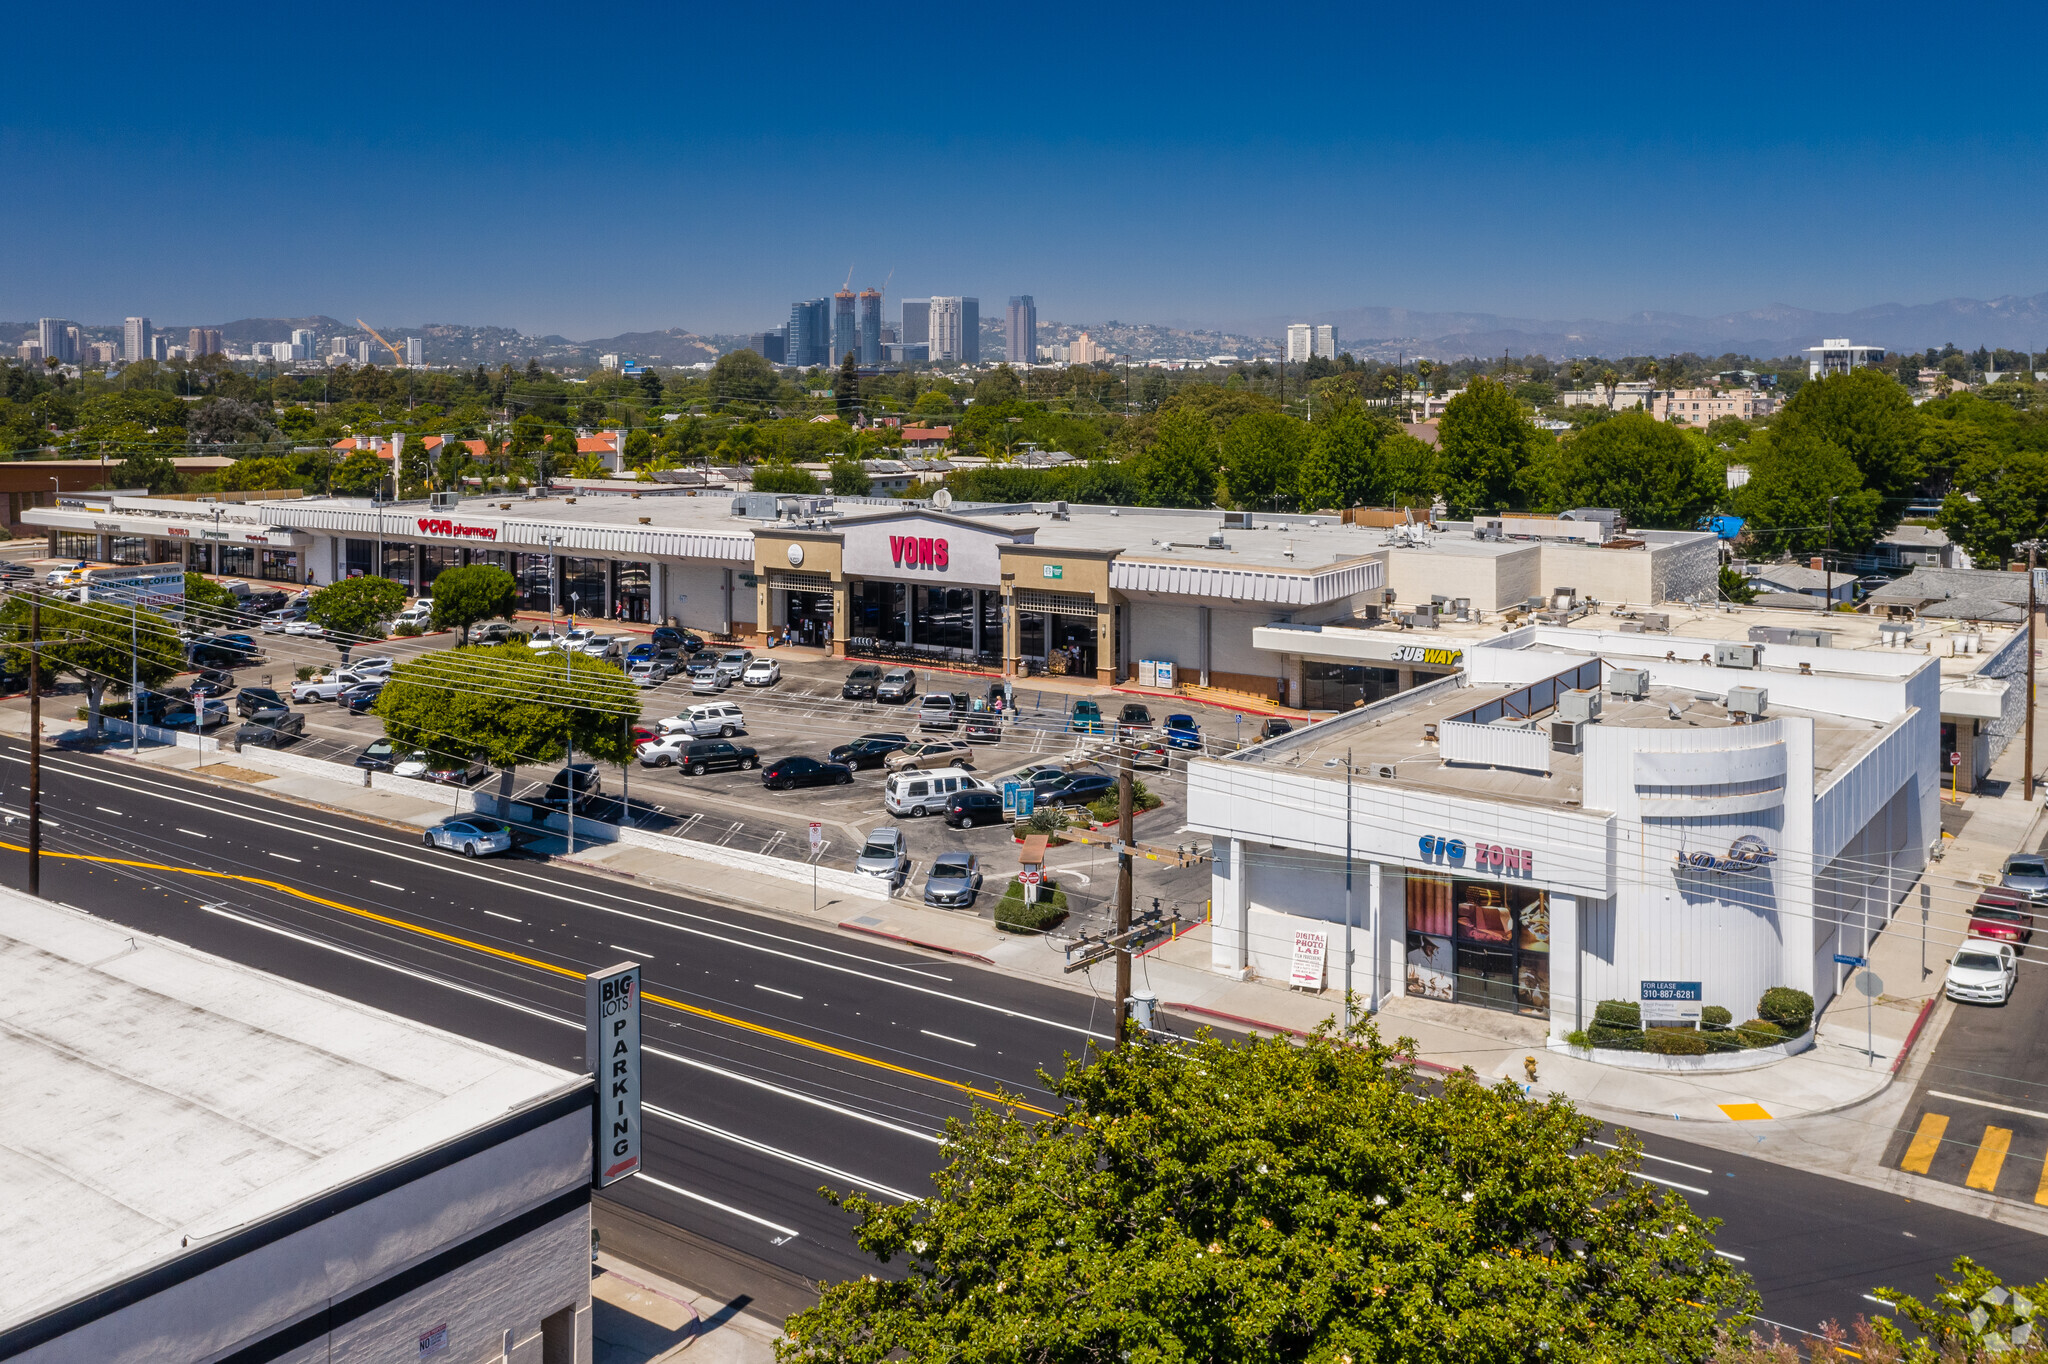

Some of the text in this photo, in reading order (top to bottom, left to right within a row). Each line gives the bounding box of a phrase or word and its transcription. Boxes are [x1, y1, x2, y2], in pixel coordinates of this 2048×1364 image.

[428, 519, 497, 540] CVS pharmacy
[889, 535, 949, 567] VONS
[89, 575, 182, 591] STARBUCKS COFFEE
[1391, 645, 1463, 665] SUBWAY
[1418, 834, 1533, 871] CIG ZONE
[1295, 931, 1325, 942] DIGITAL
[1295, 939, 1324, 949] PHOTO
[1298, 946, 1320, 955] LAB
[602, 975, 634, 1002] BIG
[1643, 990, 1695, 999] 310-887-6281
[612, 1018, 629, 1157] PARKING
[420, 1338, 430, 1352] NO
